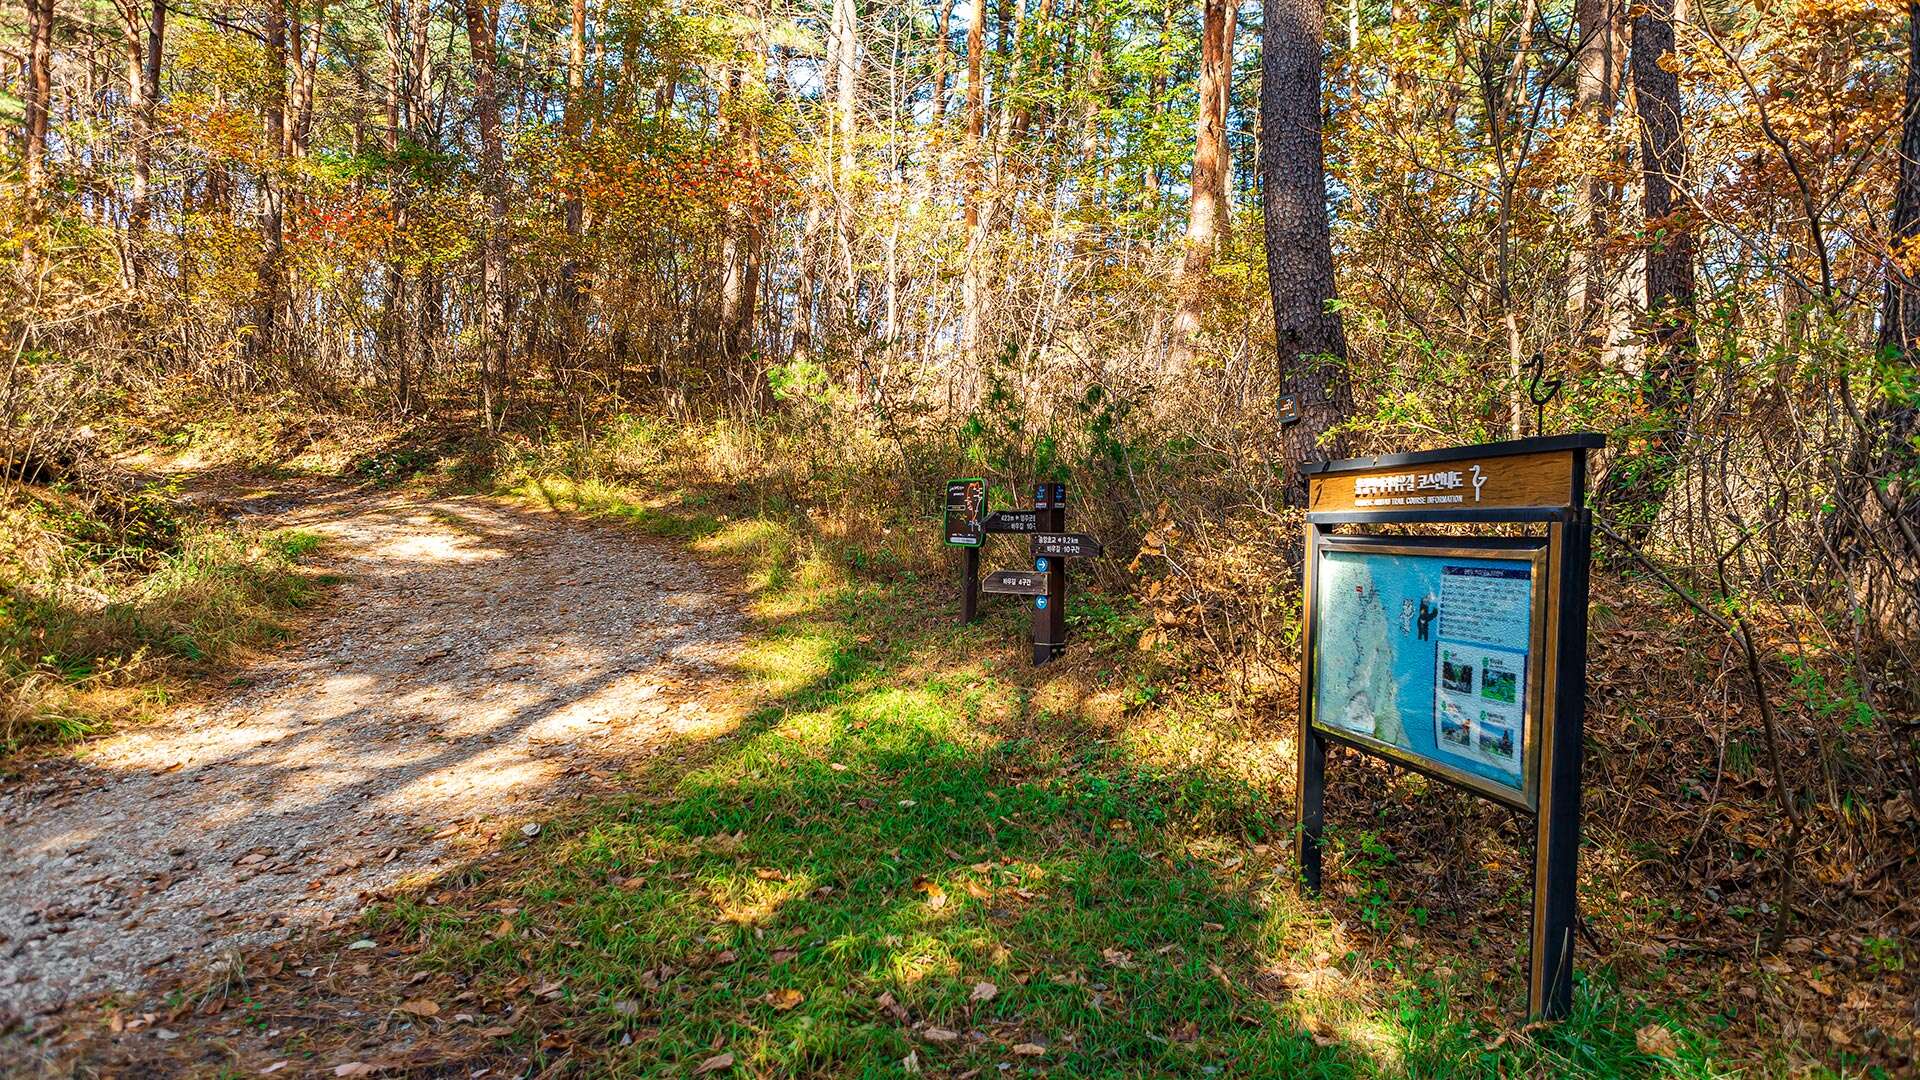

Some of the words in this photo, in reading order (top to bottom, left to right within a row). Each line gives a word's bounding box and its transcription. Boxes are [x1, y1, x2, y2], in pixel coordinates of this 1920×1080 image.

[1417, 472, 1464, 489] 코스안내도
[1406, 496, 1426, 504] COURSE
[1427, 495, 1463, 504] INFORMATION
[1046, 545, 1061, 553] 바우길
[1063, 546, 1080, 554] 10구간
[1003, 578, 1016, 586] 바우길
